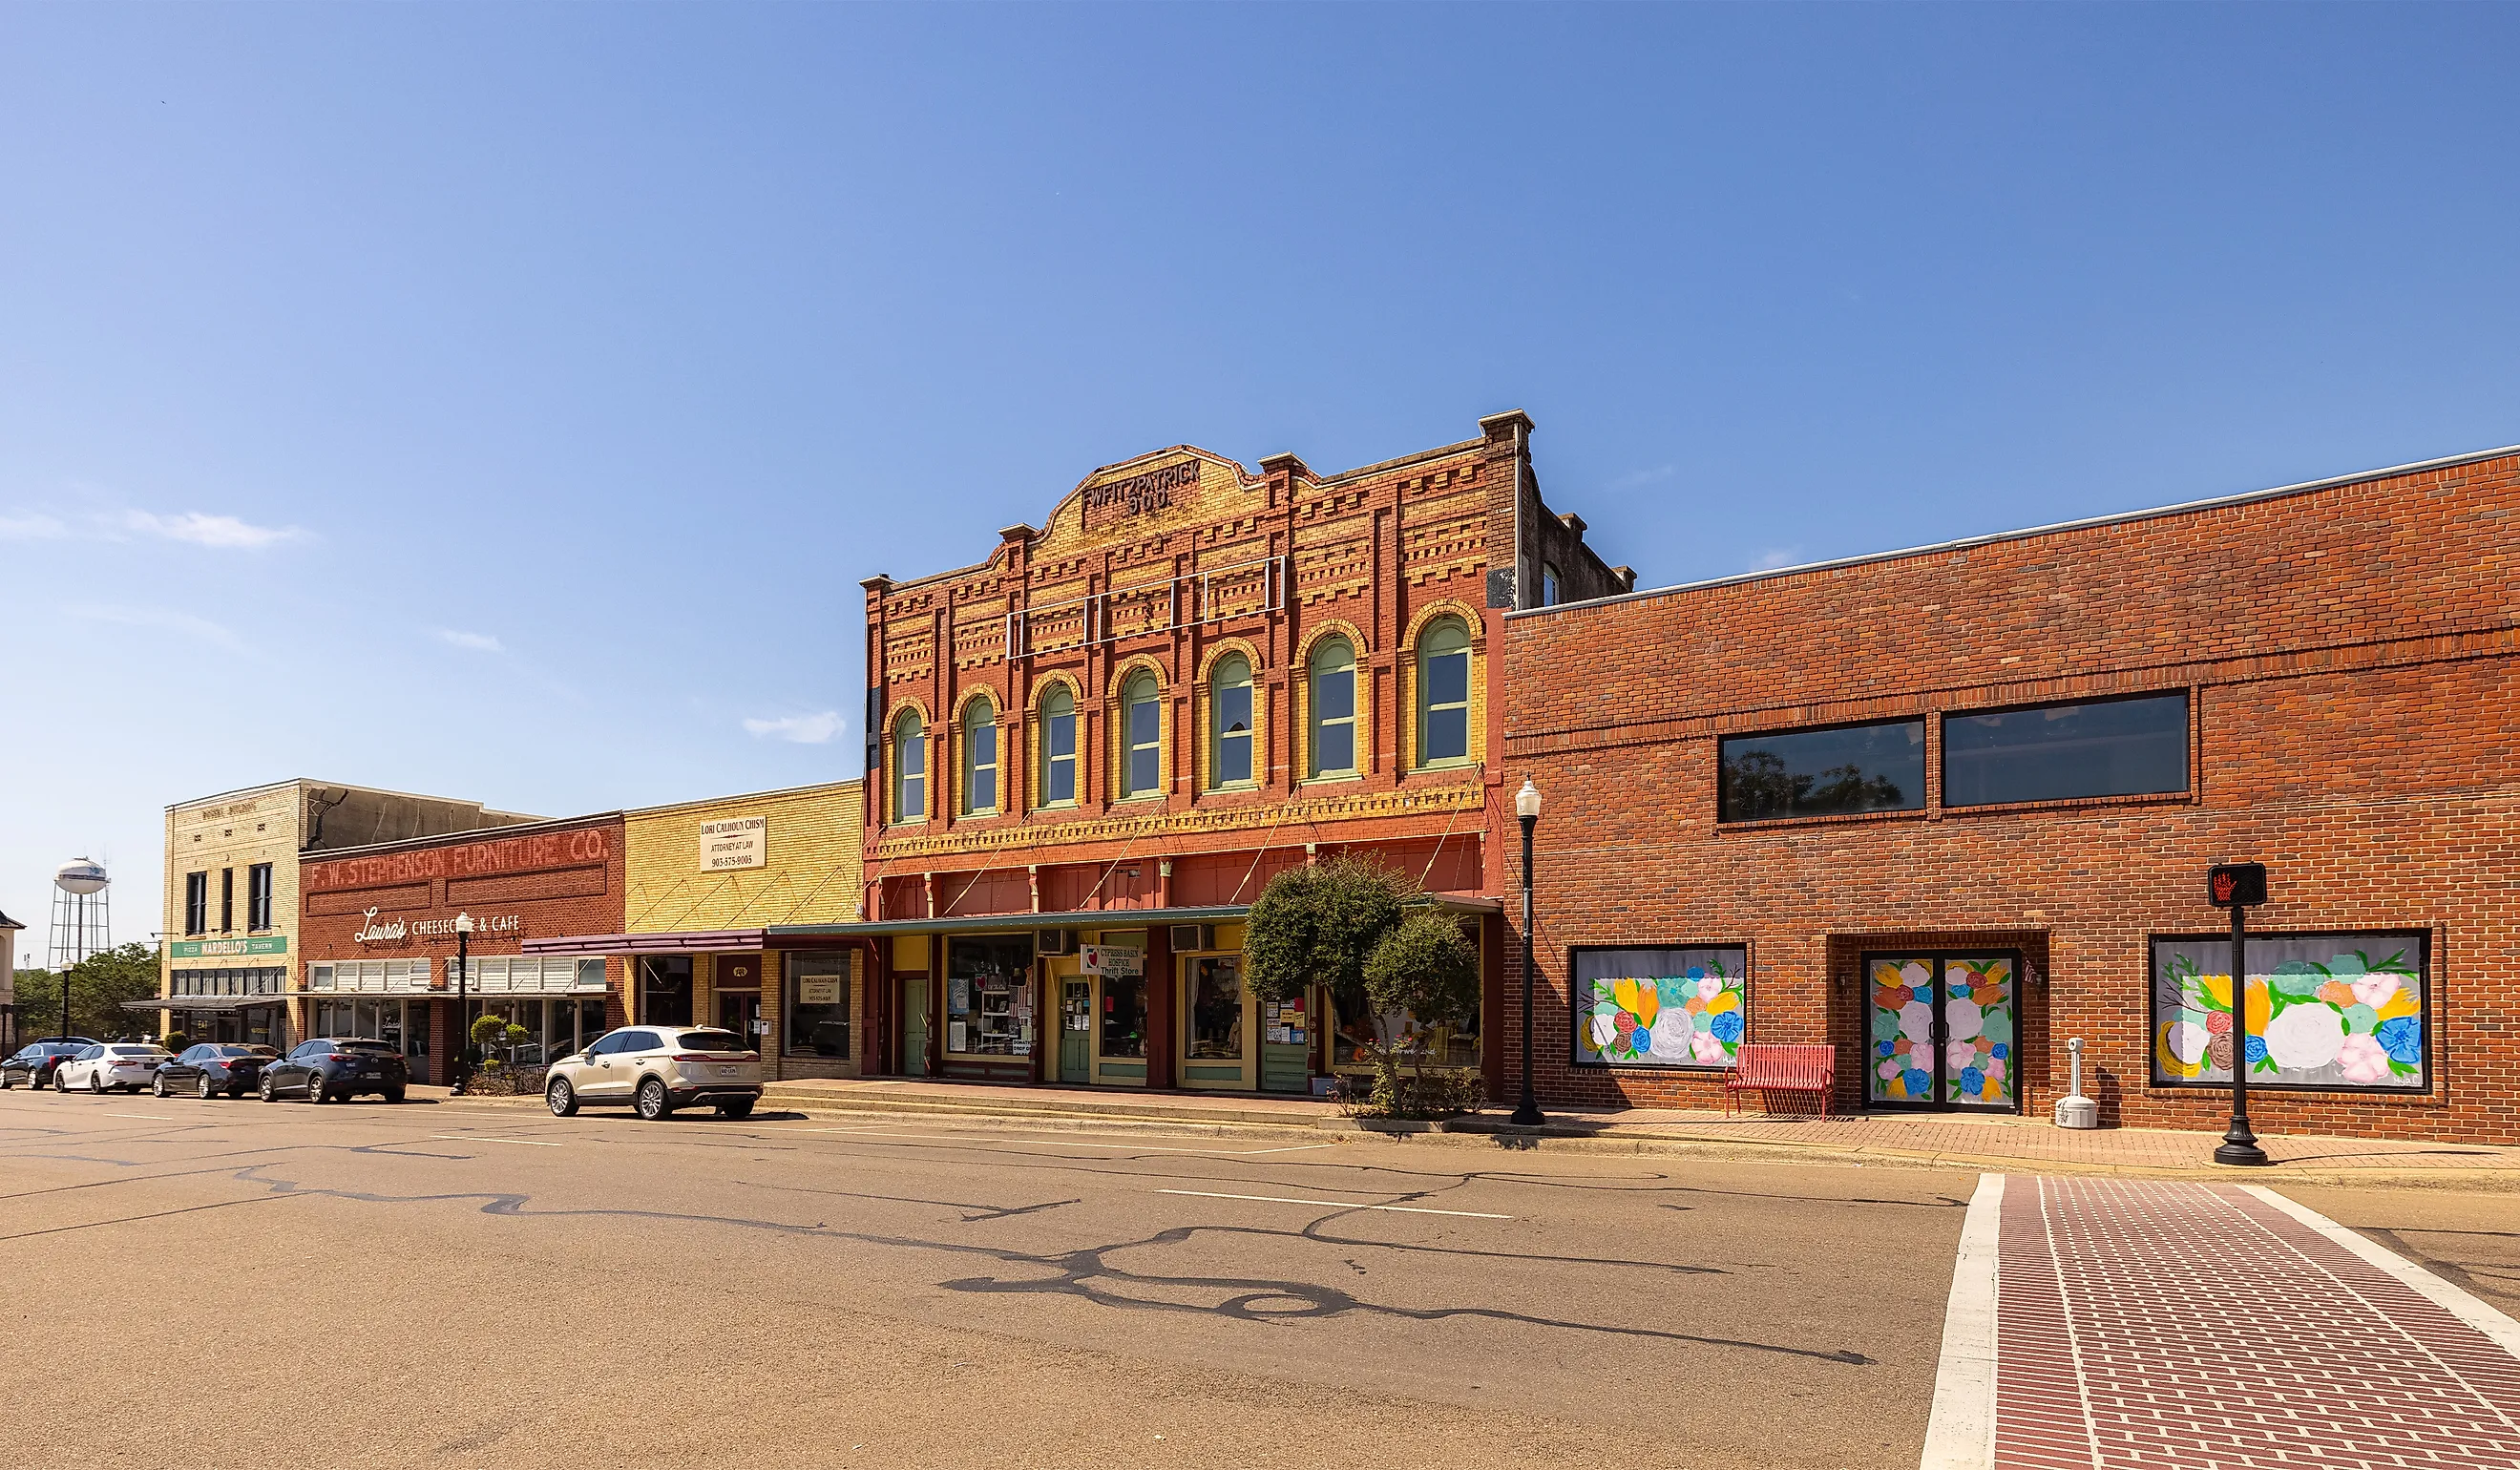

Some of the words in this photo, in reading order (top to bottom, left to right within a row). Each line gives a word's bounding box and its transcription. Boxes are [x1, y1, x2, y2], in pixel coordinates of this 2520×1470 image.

[701, 824, 715, 835] LORI
[716, 820, 745, 833] CALHOUN
[745, 817, 765, 830] CHISM
[710, 841, 736, 853] ATTORNEY
[347, 848, 446, 885] STEPHENSON
[453, 834, 559, 874] FURNITURE
[570, 830, 609, 861] CO.
[354, 906, 408, 943] Laura's
[479, 917, 487, 933] &
[492, 914, 519, 932] CAFE
[183, 945, 198, 954] PIZZA
[201, 939, 248, 956] NARDELLO'S
[252, 941, 273, 950] TAVERN
[1101, 966, 1119, 975] Thrift
